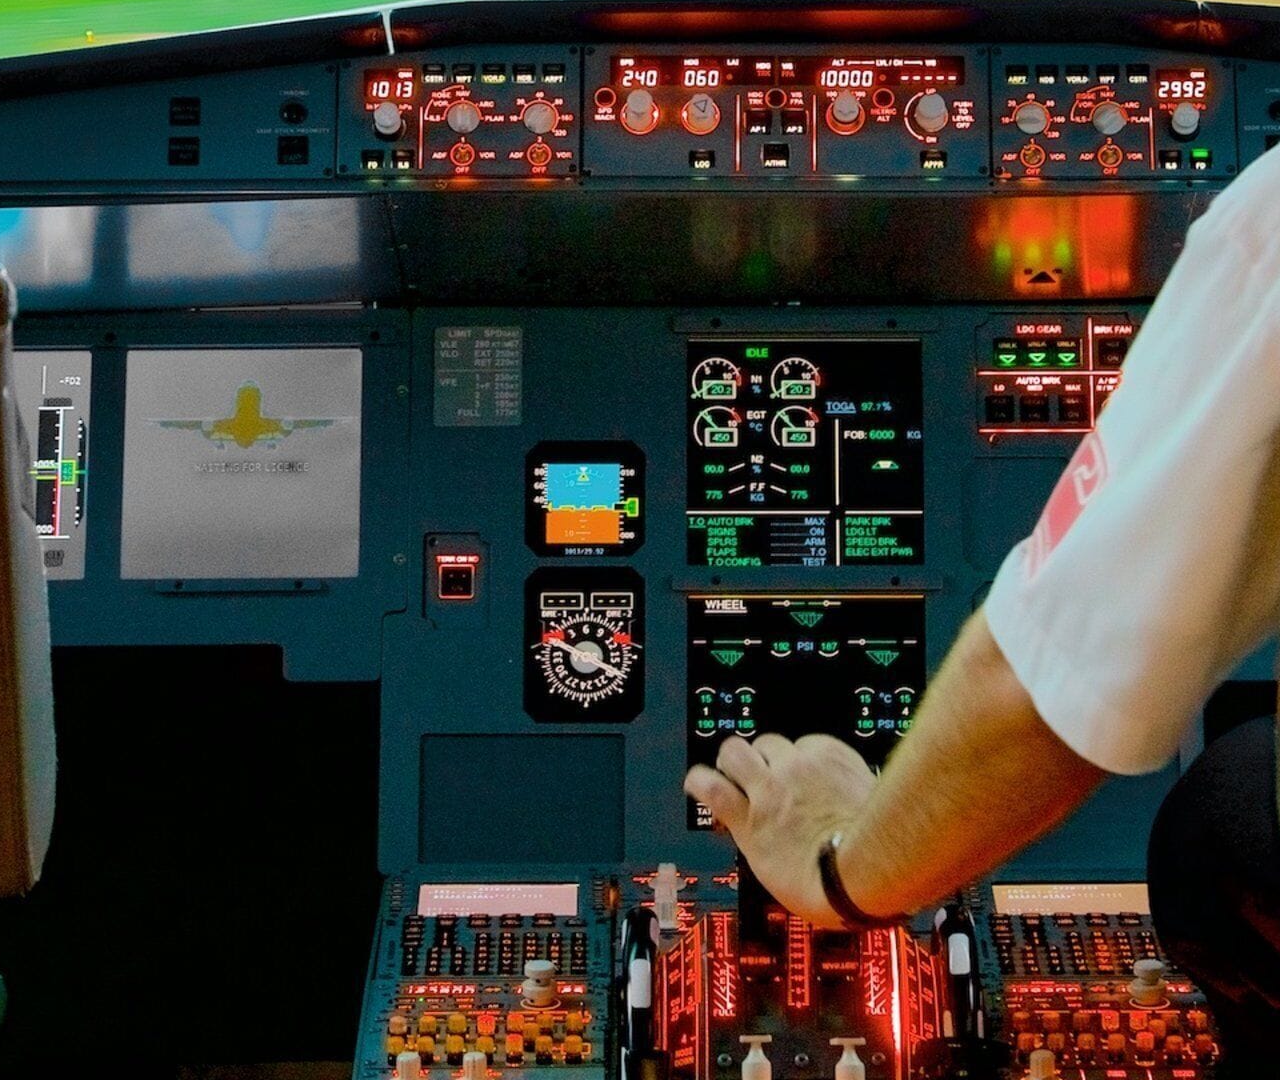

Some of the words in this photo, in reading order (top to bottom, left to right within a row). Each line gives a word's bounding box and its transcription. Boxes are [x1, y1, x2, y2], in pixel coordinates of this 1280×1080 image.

[622, 70, 658, 86] 240
[684, 70, 719, 86] 060
[820, 71, 873, 87] 10000
[372, 81, 413, 98] 1013
[1158, 81, 1206, 98] 2992
[746, 348, 769, 358] IDLE
[751, 375, 763, 383] N1
[711, 385, 731, 394] 20.2
[790, 385, 810, 394] 20.2
[826, 402, 855, 411] TOGA
[746, 411, 767, 419] EGT
[712, 433, 730, 442] 450
[789, 433, 808, 442] 450
[869, 431, 895, 439] 6000
[907, 431, 922, 439] KG
[751, 455, 764, 464] N2
[242, 463, 261, 472] FOR
[264, 463, 310, 472] LICENCE
[705, 491, 723, 500] 775
[750, 493, 764, 501] KG
[791, 491, 808, 500] 775
[707, 517, 734, 525] AUTO
[805, 517, 825, 525] MAX
[845, 517, 871, 526] PARK
[707, 528, 737, 536] SIGNS
[809, 528, 824, 536] ON
[845, 527, 865, 536] LDG
[866, 527, 877, 536] LT
[804, 538, 825, 546] ARM
[845, 537, 877, 546] SPEED
[706, 548, 737, 556] FLAPS
[845, 548, 869, 556] ELEC
[870, 548, 890, 556] EXT
[891, 548, 913, 556] PWR
[724, 558, 761, 566] CONFIG
[802, 558, 826, 566] TEST
[705, 600, 747, 610] WHEEL
[582, 624, 590, 635] 6
[773, 641, 790, 650] 192
[797, 641, 814, 650] PSI
[700, 694, 712, 703] 15
[740, 694, 752, 703] 15
[859, 694, 871, 703] 15
[899, 694, 912, 703] 15
[703, 707, 708, 716] 1
[742, 707, 750, 716] 2
[862, 707, 869, 716] 3
[902, 707, 910, 716] 4
[698, 720, 715, 729] 190
[718, 720, 735, 729] PSI
[878, 720, 895, 729] PSI
